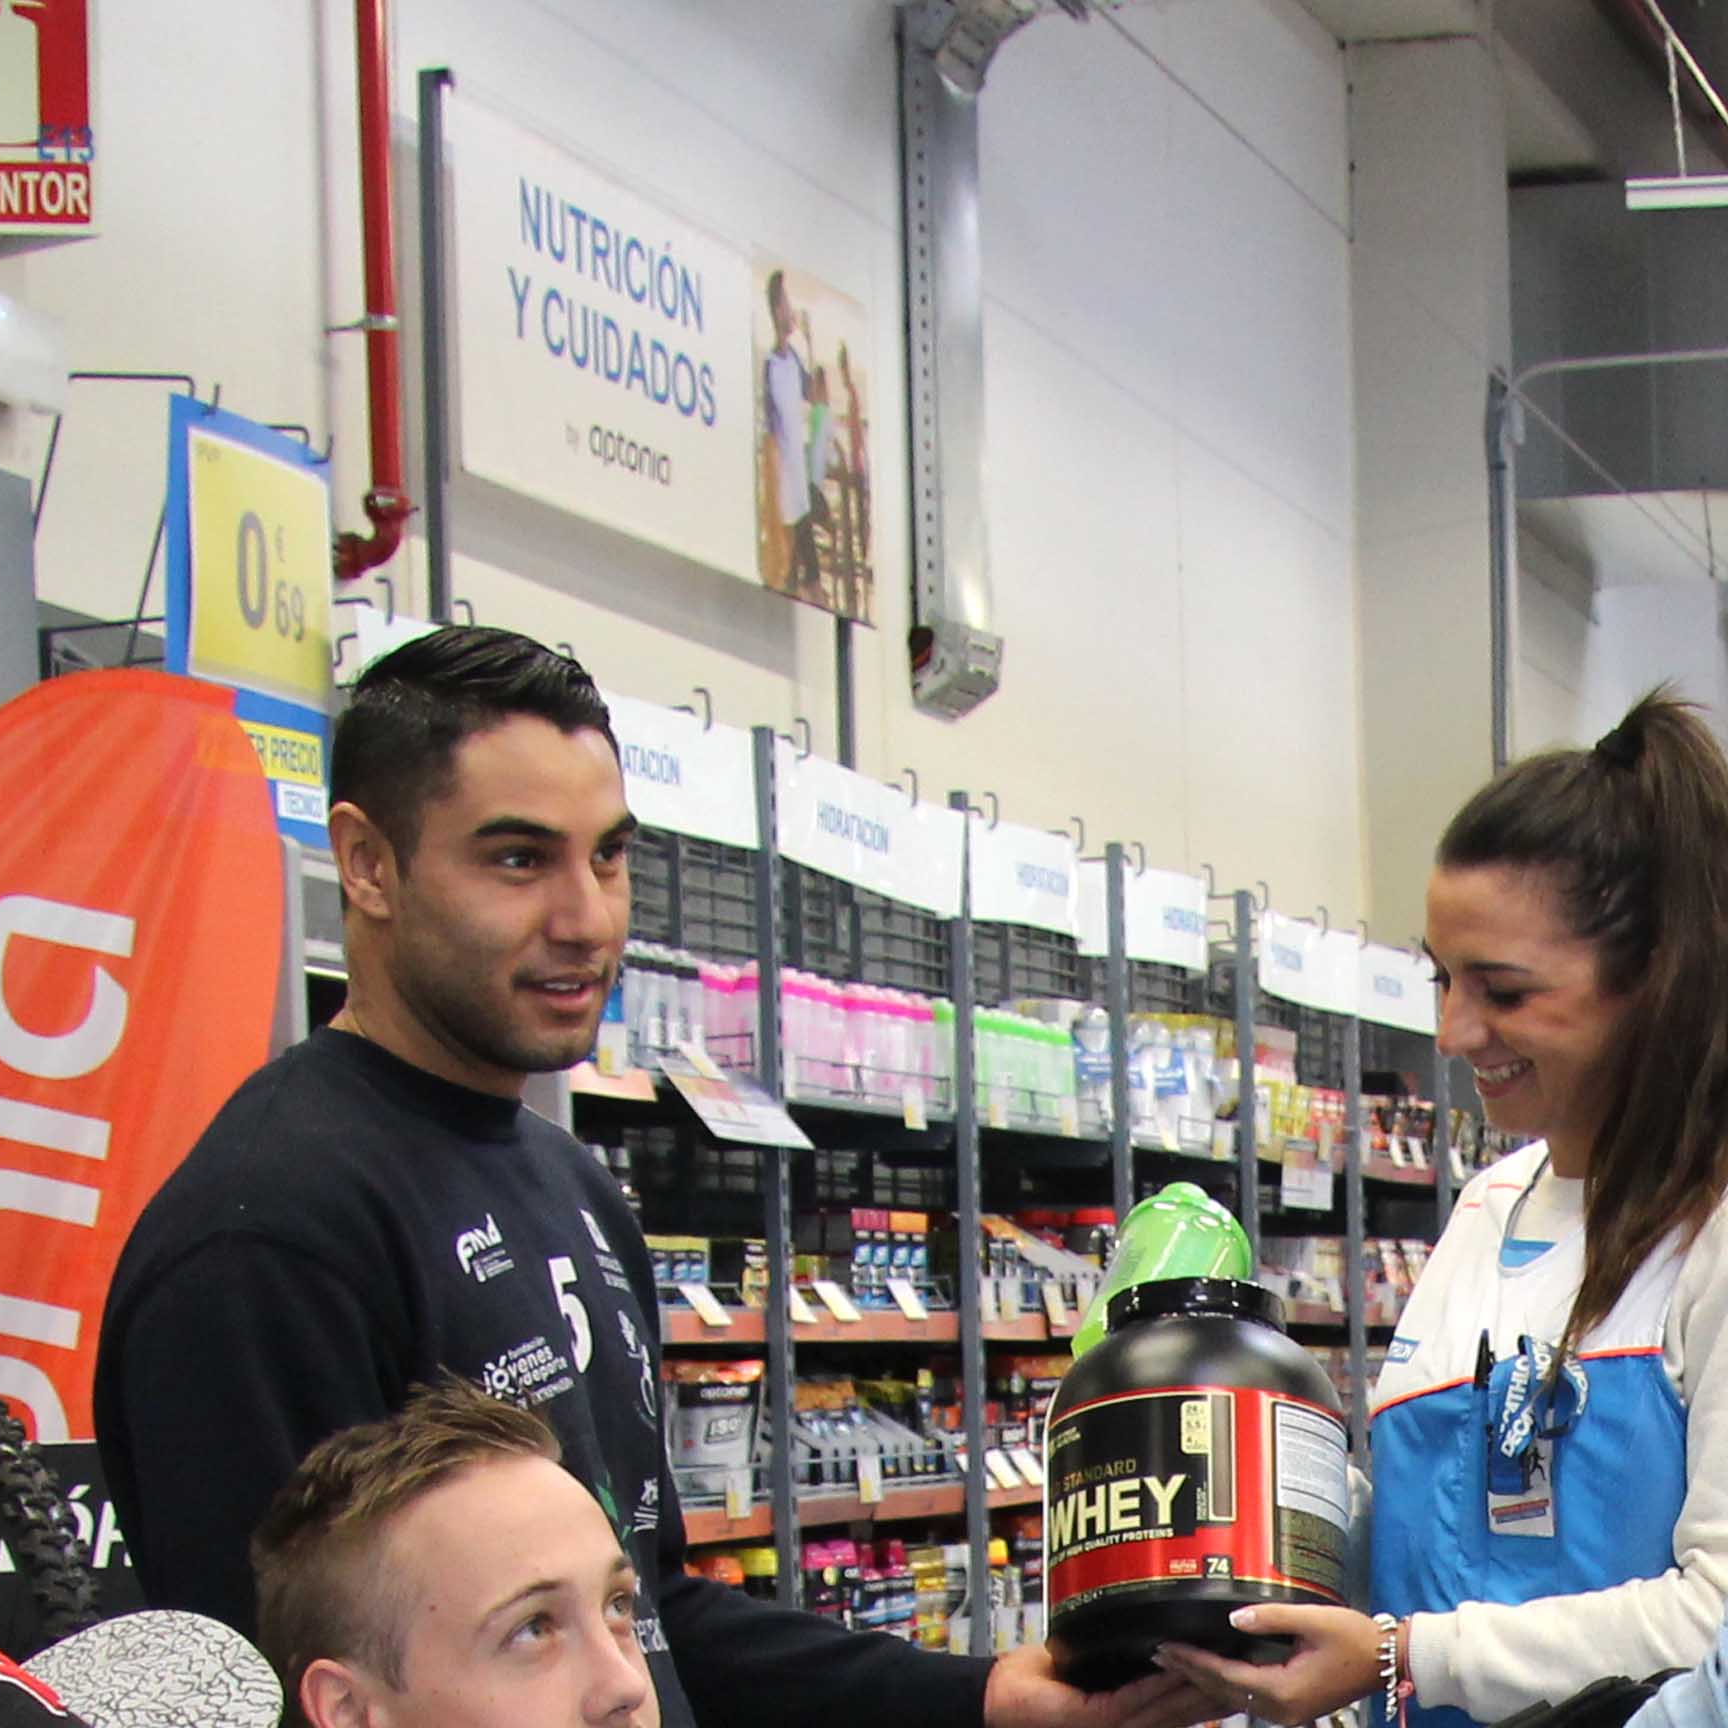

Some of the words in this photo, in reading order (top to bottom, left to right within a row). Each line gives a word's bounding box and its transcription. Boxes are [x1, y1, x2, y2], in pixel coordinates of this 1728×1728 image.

[36, 124, 96, 163] E13
[518, 176, 704, 334] NUTRICIÓN
[506, 265, 532, 340] Y
[540, 287, 717, 428] CUIDADOS
[587, 423, 673, 487] aptonia
[548, 1256, 592, 1374] 5
[1063, 1457, 1137, 1492] STANDARD
[1050, 1473, 1187, 1555] WHEY
[1207, 1557, 1230, 1575] 74
